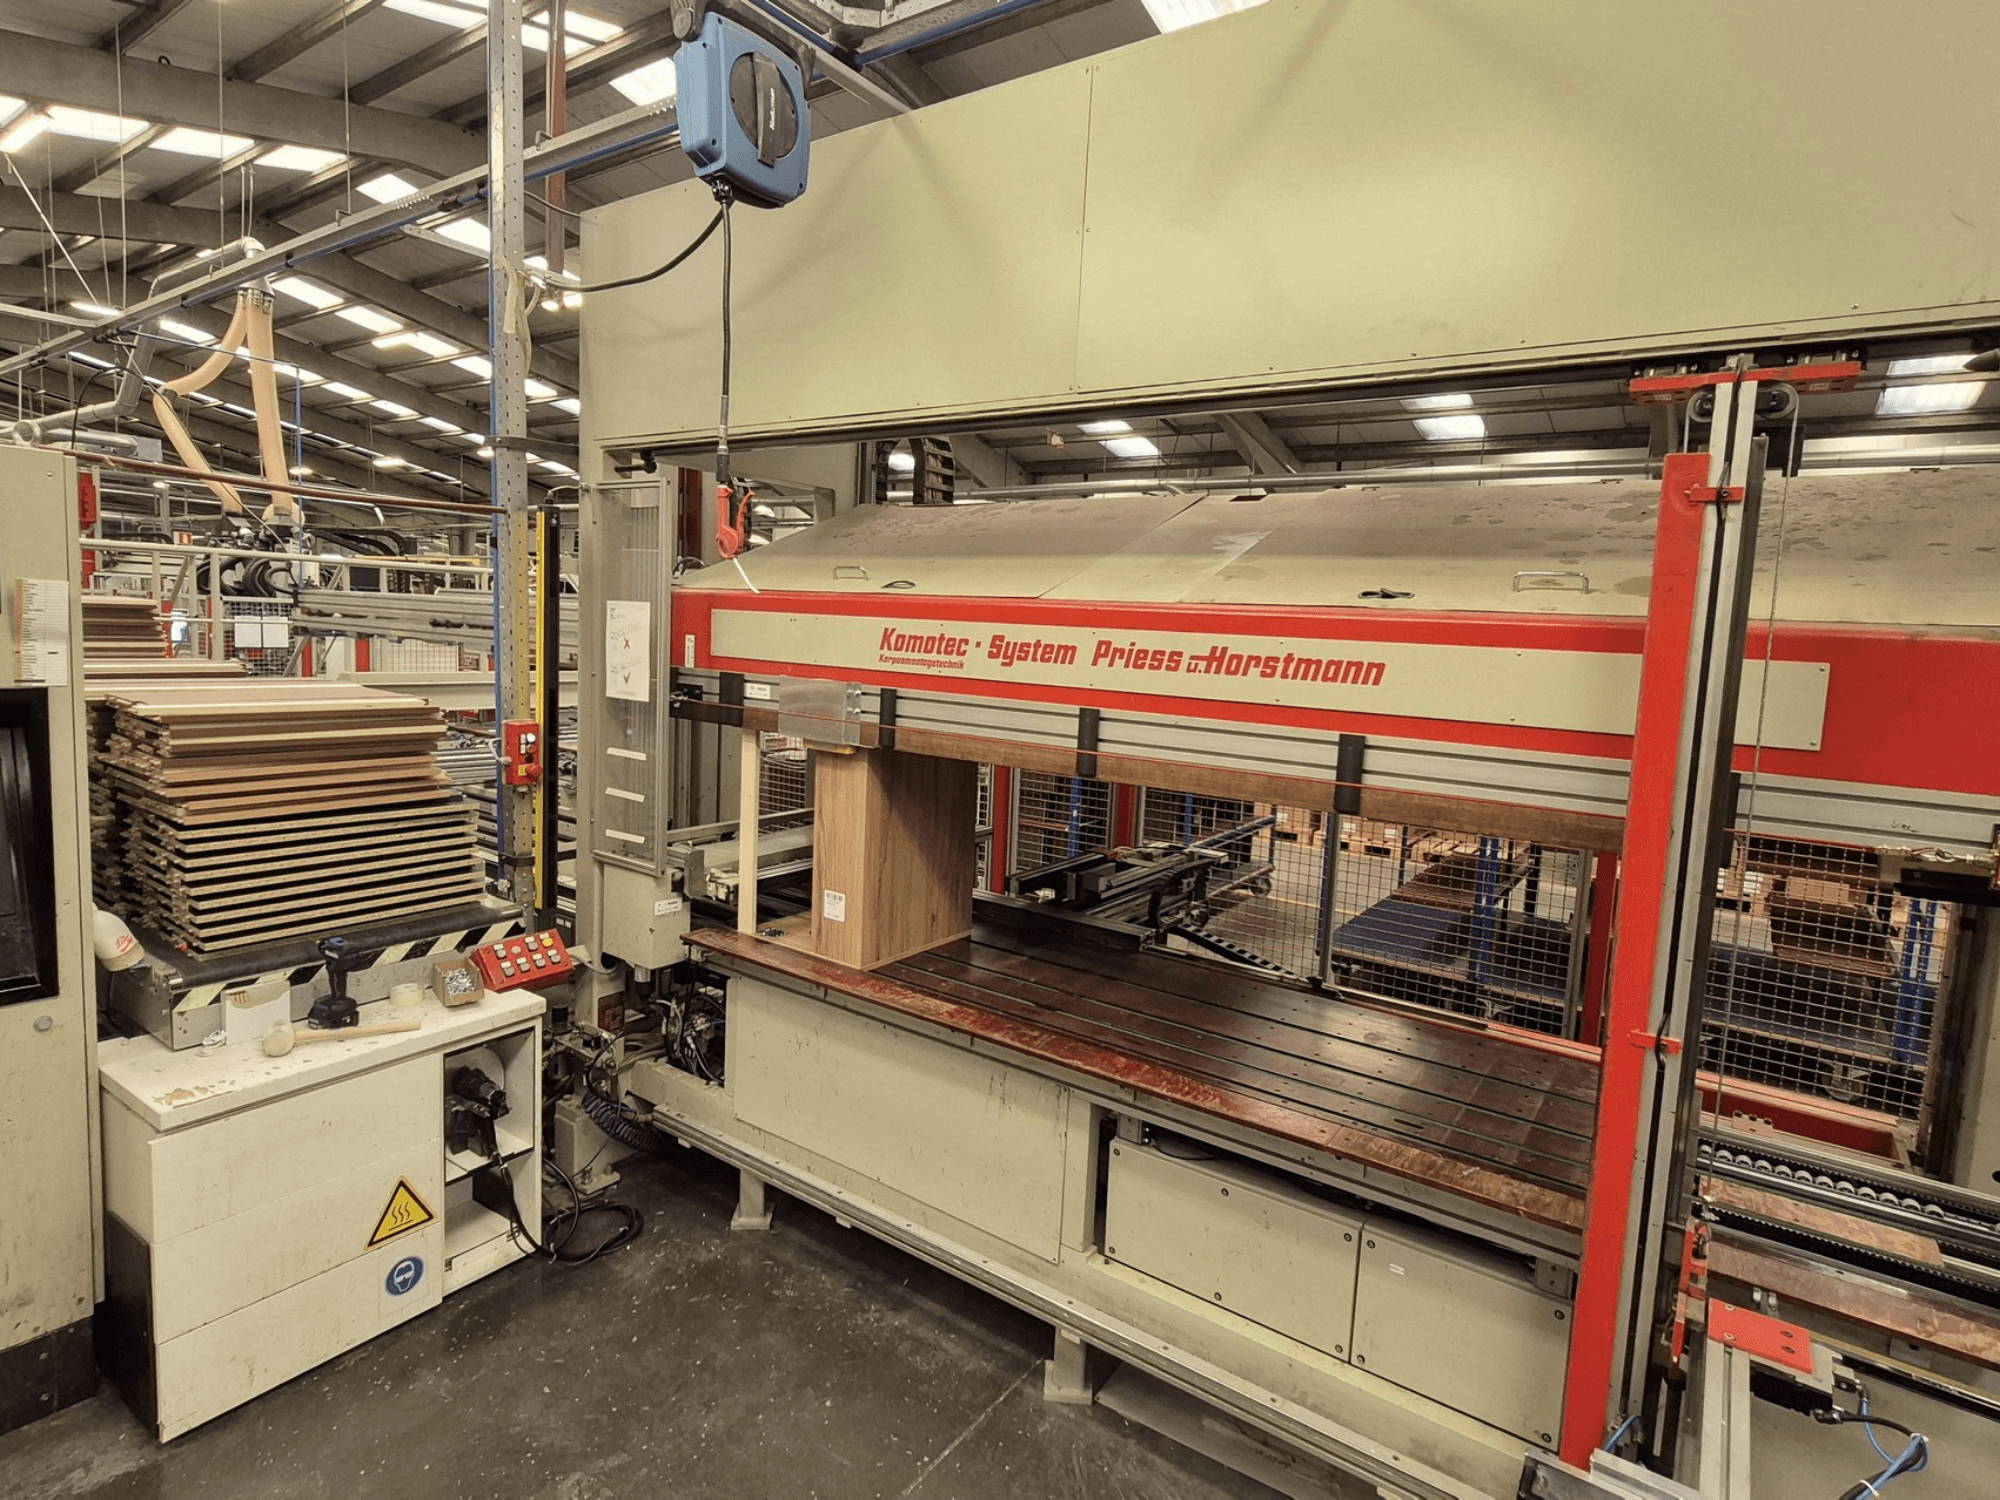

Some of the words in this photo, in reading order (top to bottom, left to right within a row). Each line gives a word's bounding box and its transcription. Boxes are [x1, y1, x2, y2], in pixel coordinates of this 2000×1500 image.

[987, 634, 1077, 667] System
[1091, 639, 1183, 672] Priess
[1190, 646, 1386, 686] Horstmann
